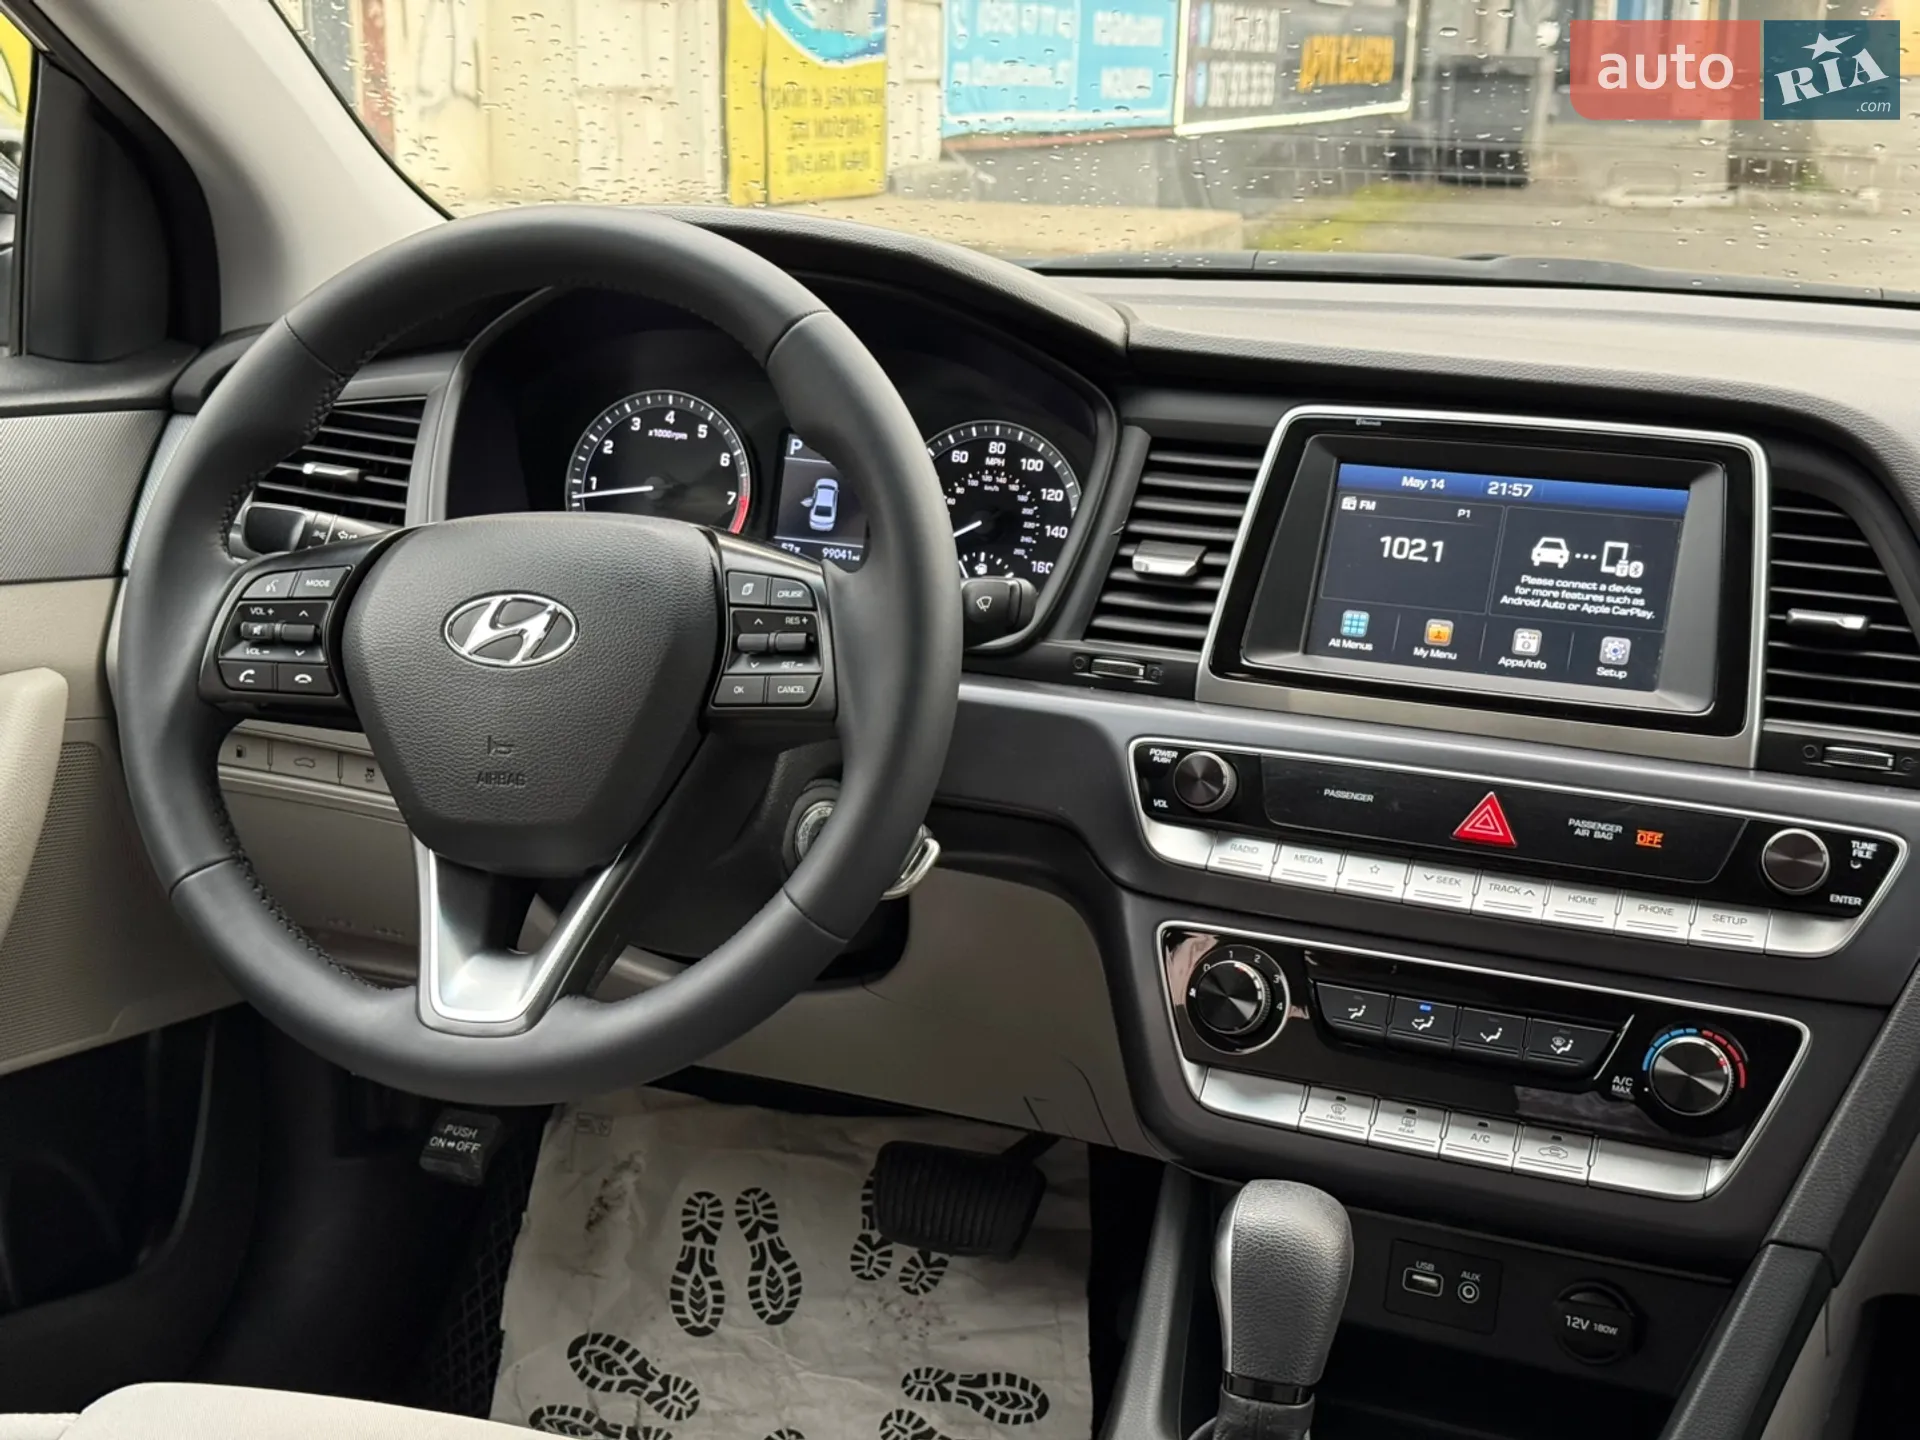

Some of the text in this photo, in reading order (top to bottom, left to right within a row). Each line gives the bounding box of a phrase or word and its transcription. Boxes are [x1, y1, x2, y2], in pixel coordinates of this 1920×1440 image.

[630, 417, 642, 431] 3
[664, 410, 676, 425] 4
[697, 424, 709, 439] 5
[603, 439, 615, 454] 2
[789, 439, 803, 455] P
[988, 441, 1006, 455] 80
[720, 452, 731, 467] 6
[951, 450, 969, 464] 60
[985, 457, 1005, 467] MPH
[1020, 458, 1044, 472] 100
[589, 476, 598, 490] 1
[1401, 476, 1446, 491] May 14
[1487, 481, 1533, 498] 21:57
[727, 491, 737, 505] 7
[1040, 488, 1064, 503] 120
[1359, 500, 1377, 511] FM
[1457, 509, 1471, 518] P1
[1045, 525, 1068, 539] 140
[305, 579, 331, 588] MODE
[1520, 575, 1554, 587] Please
[1555, 579, 1597, 591] connect
[1608, 583, 1643, 595] device
[777, 590, 804, 598] CRUISE
[1515, 585, 1646, 606] for more features such as
[250, 607, 266, 616] VOL
[1500, 595, 1656, 620] Android Auto or Apple CarPlay.
[785, 617, 800, 625] RES
[1328, 638, 1374, 651] All Menus
[246, 648, 262, 656] VOL
[1413, 647, 1458, 661] My Menu
[1498, 656, 1547, 670] Apps/Info
[1596, 667, 1628, 680] Setup
[733, 685, 745, 694] OK
[777, 685, 806, 694] CANCEL
[1149, 748, 1179, 759] POWER
[476, 771, 526, 786] AIRBAG
[1323, 788, 1375, 803] PASSENGER
[1153, 798, 1169, 808] VOL
[1568, 817, 1623, 834] PASSENGER
[1574, 827, 1614, 841] AIR BAG
[1636, 831, 1664, 847] OFF
[1229, 842, 1260, 855] RADIO
[1851, 840, 1878, 852] TUNE
[1294, 853, 1324, 866] MEDIA
[1853, 849, 1873, 859] FILE
[1436, 875, 1462, 887] SEEK
[1488, 882, 1522, 896] TRACK
[1567, 893, 1599, 906] HOME
[1829, 894, 1863, 906] ENTER
[1637, 903, 1675, 917] PHONE
[1712, 913, 1748, 926] SETUP
[1611, 1075, 1634, 1088] A/C
[1611, 1084, 1632, 1095] MAX
[443, 1124, 478, 1138] PUSH
[1470, 1132, 1491, 1144] A/C
[429, 1136, 481, 1154] ON OFF
[1415, 1260, 1435, 1272] USB
[1460, 1271, 1481, 1282] AUX
[1565, 1314, 1590, 1331] 12V
